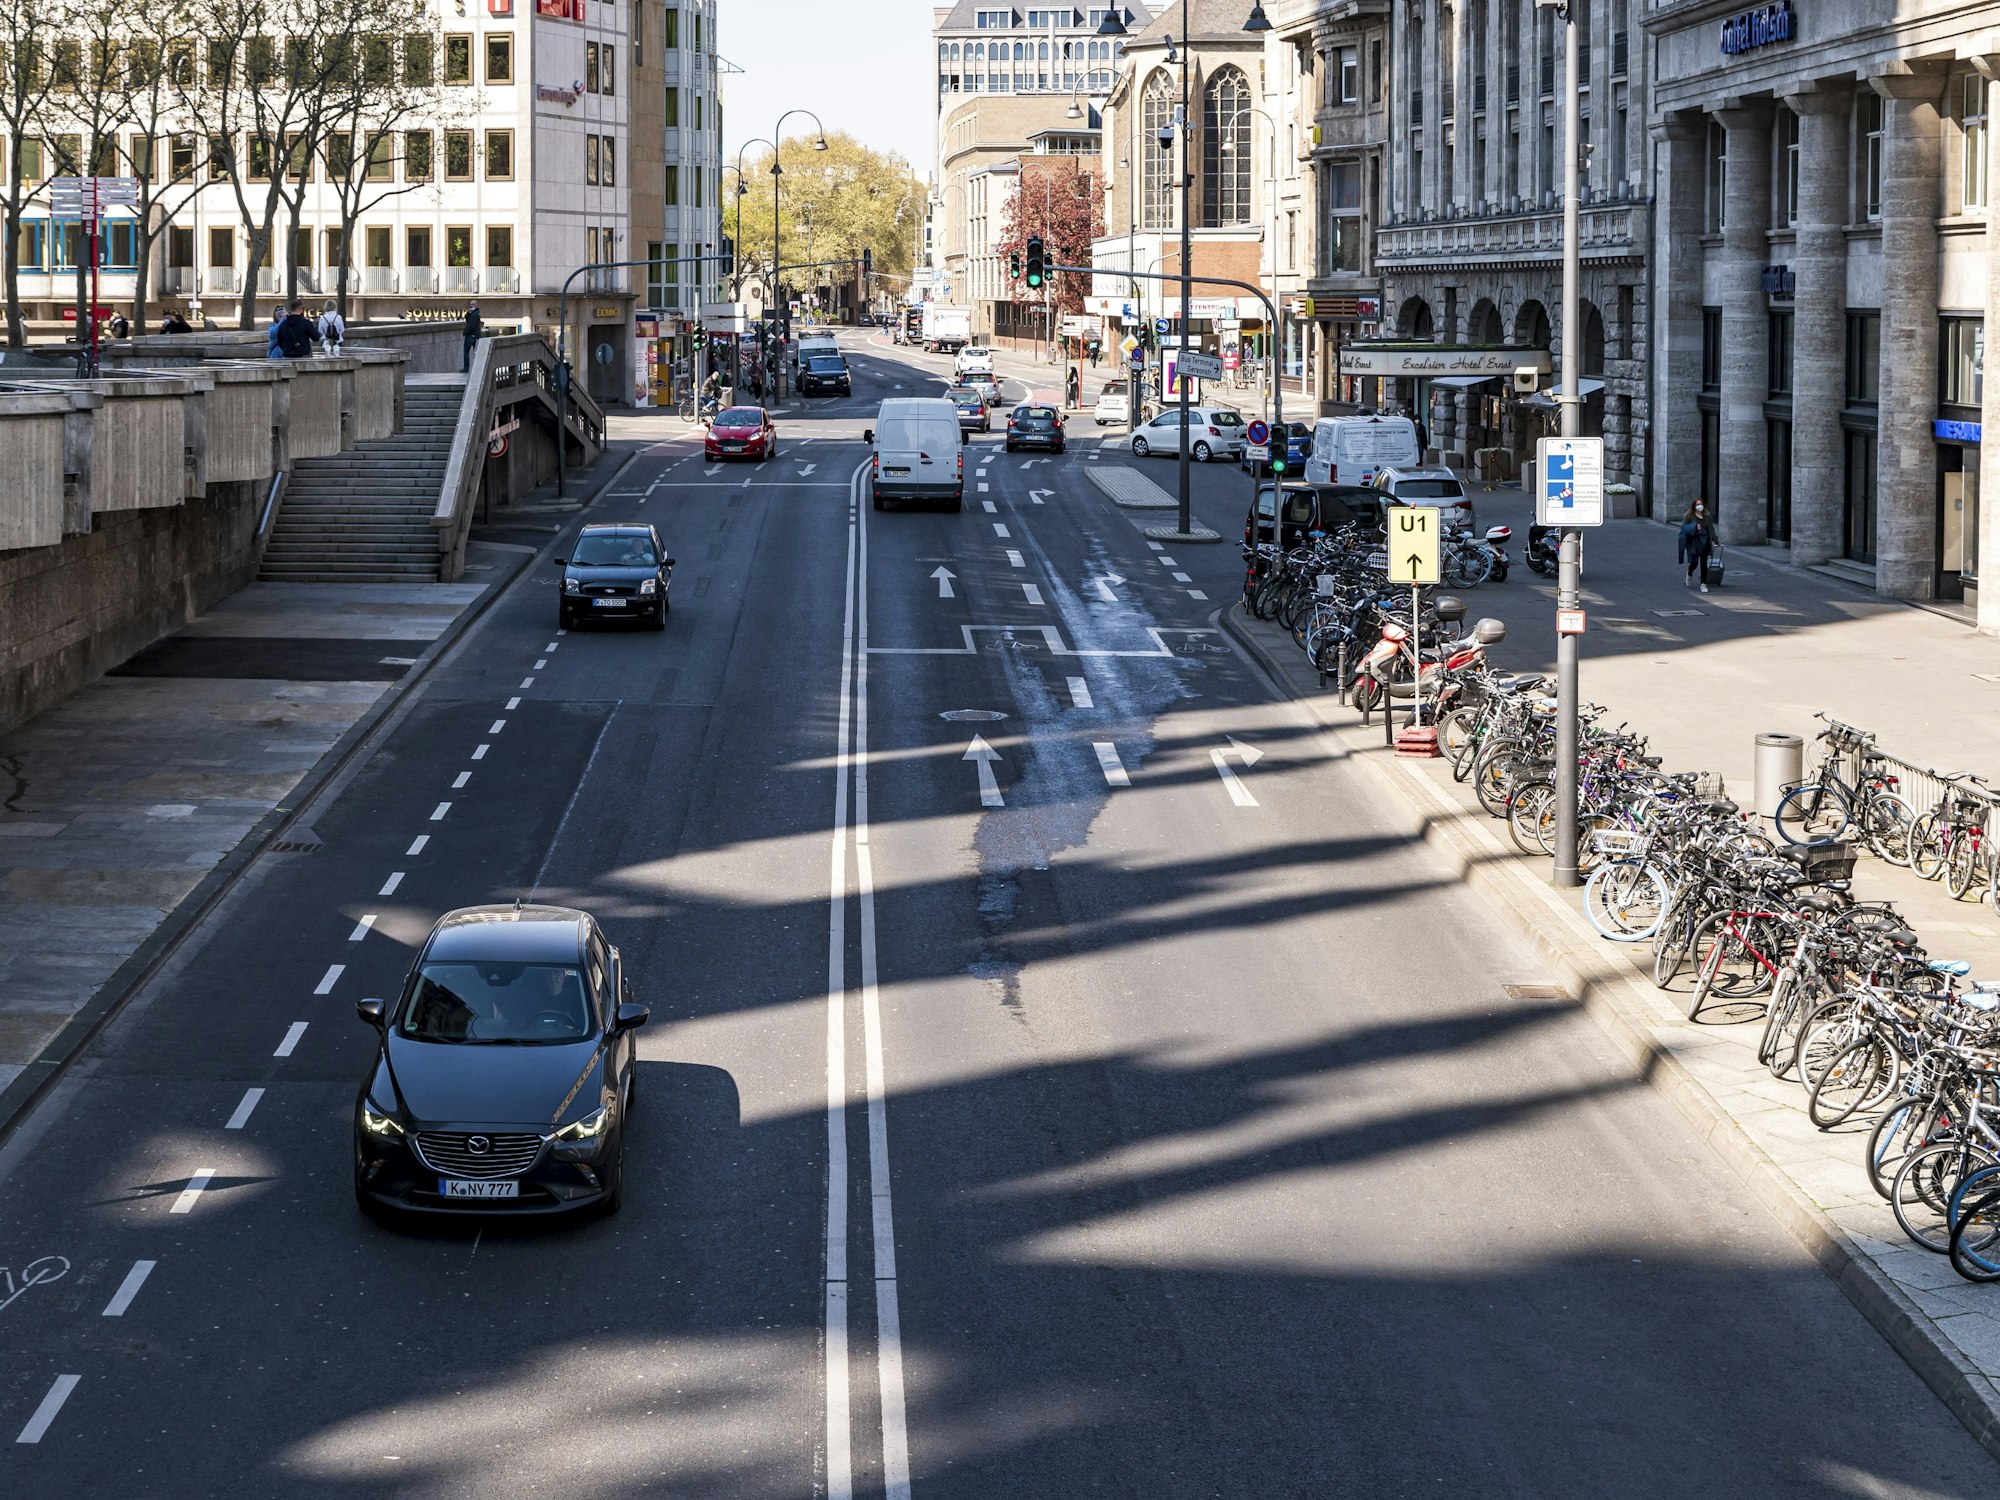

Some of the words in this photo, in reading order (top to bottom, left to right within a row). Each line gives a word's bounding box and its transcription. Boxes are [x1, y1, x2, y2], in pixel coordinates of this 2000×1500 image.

[1720, 15, 1750, 54] Gaffel
[1751, 2, 1789, 47] Kölsch
[1181, 354, 1191, 363] Bus
[1192, 356, 1214, 367] Terminal
[1354, 356, 1372, 369] Ernst
[1401, 356, 1446, 369] Excelsior
[1449, 354, 1484, 369] Hotel
[1486, 357, 1512, 369] Ernst
[1187, 364, 1213, 376] Gereonstr.
[1401, 515, 1425, 532] U1
[488, 1183, 513, 1196] 777
